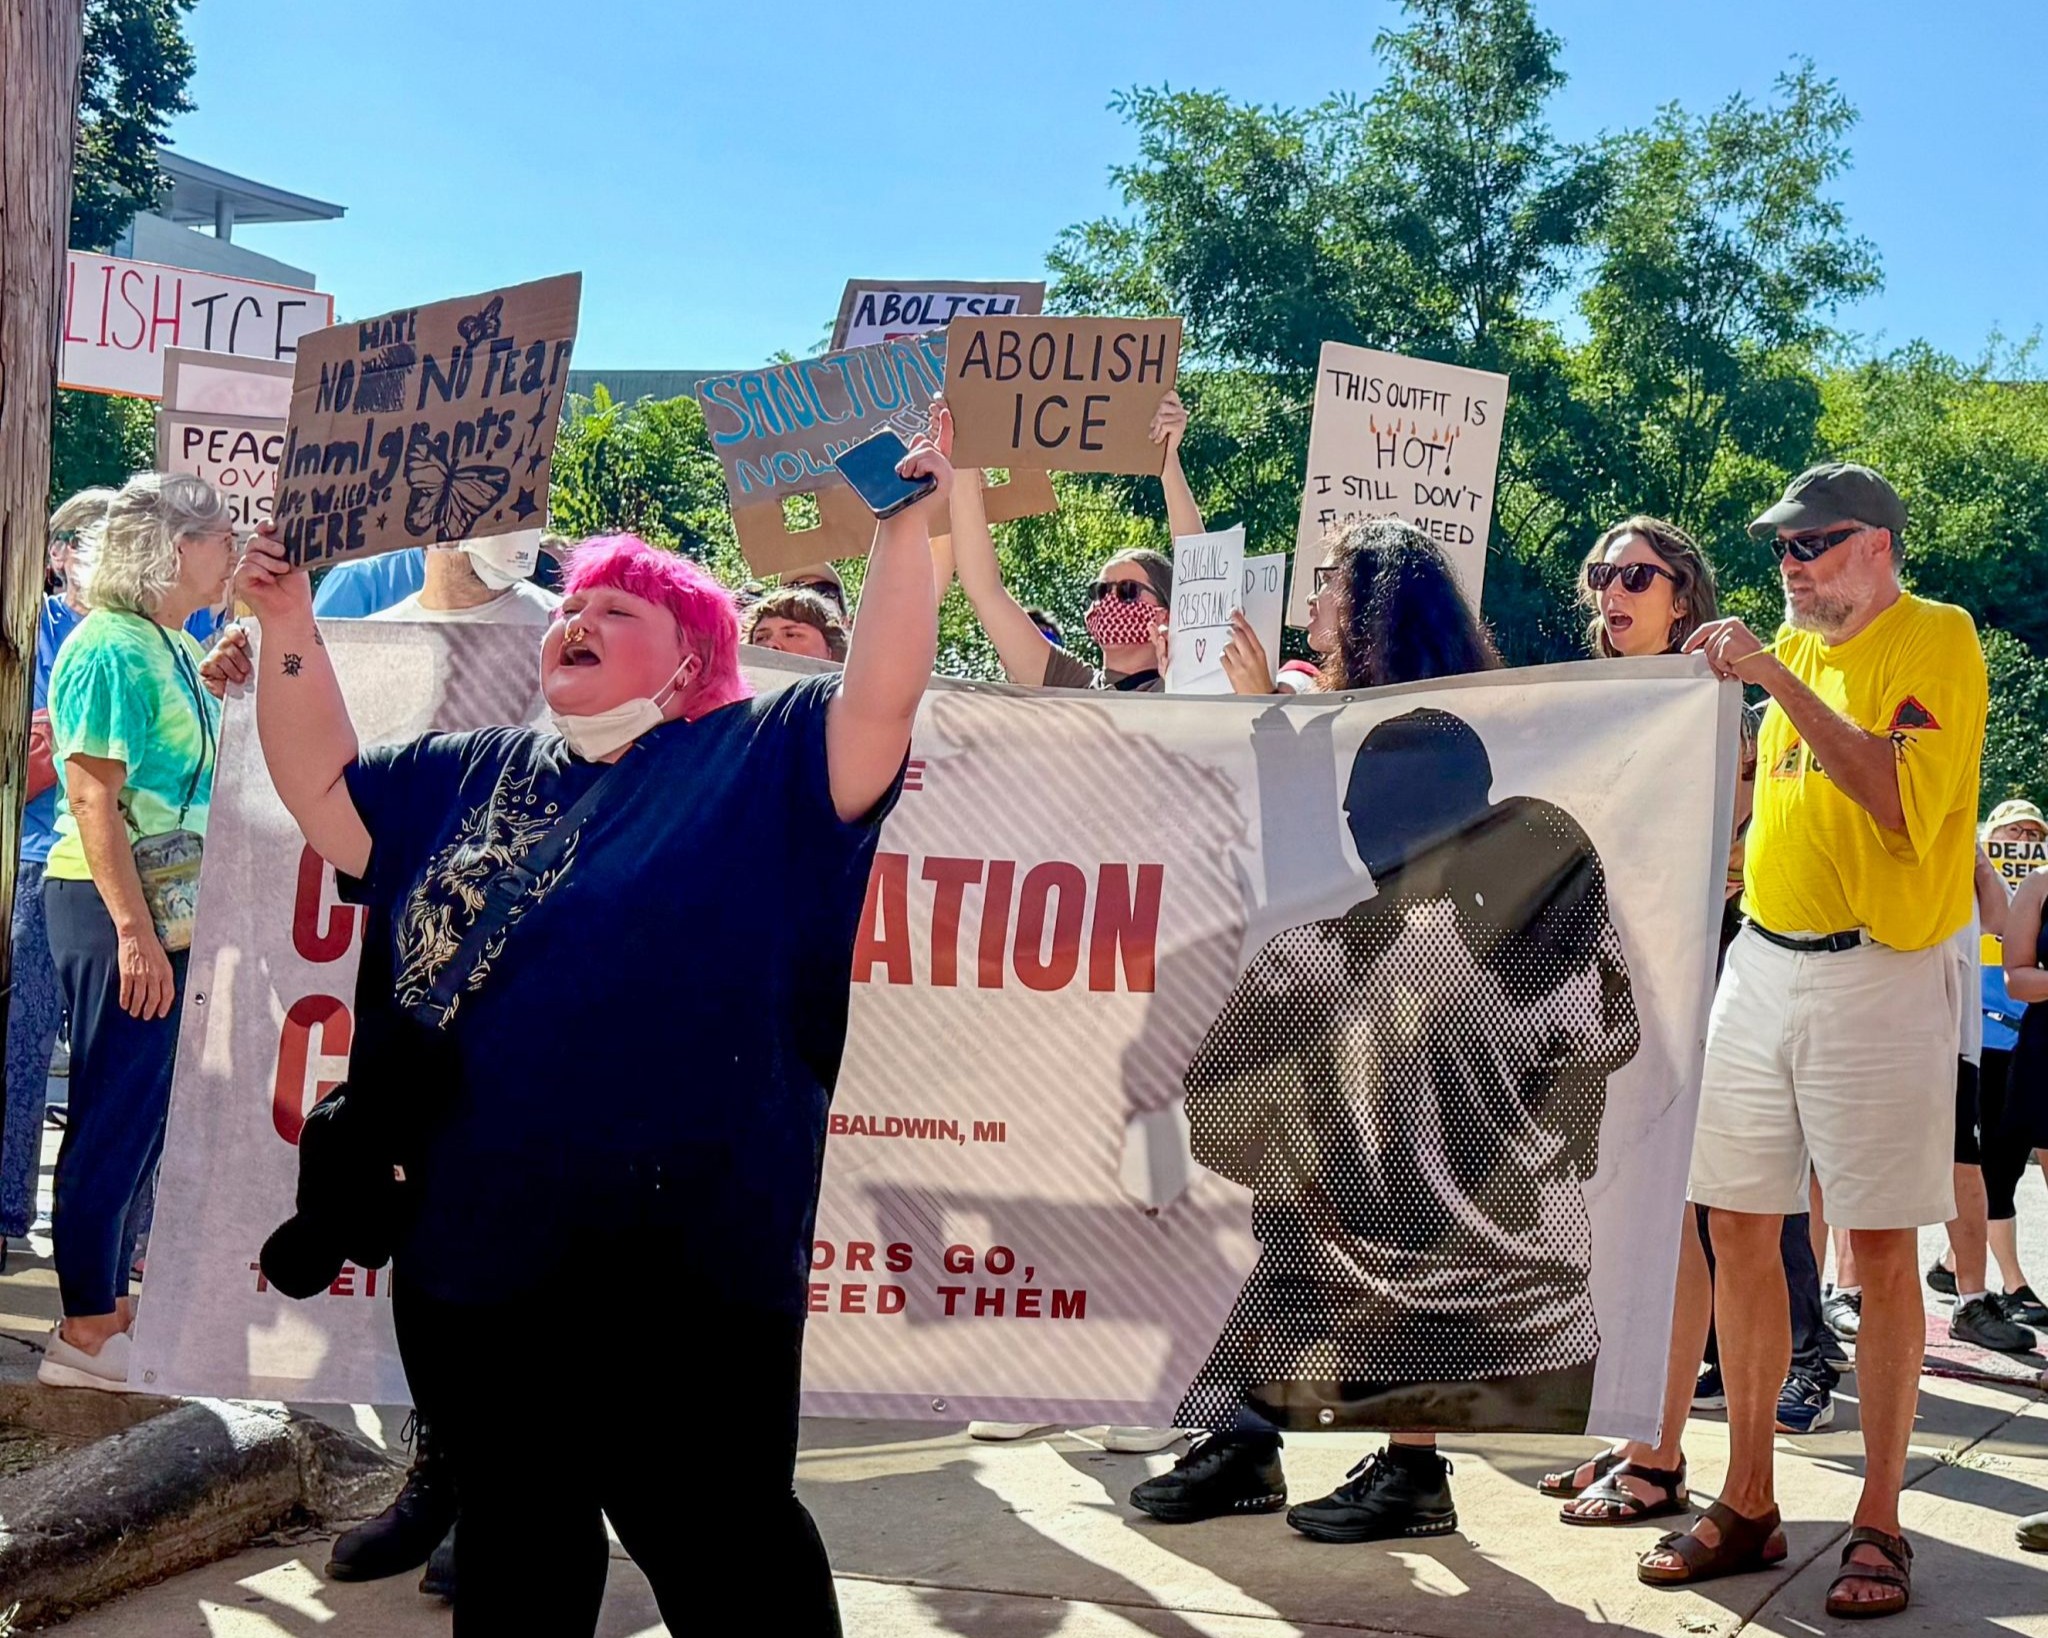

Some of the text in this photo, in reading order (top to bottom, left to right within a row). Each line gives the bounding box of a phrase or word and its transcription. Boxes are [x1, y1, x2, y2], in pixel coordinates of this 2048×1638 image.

[64, 262, 182, 353] LISH
[359, 311, 418, 351] HATE
[958, 330, 1166, 384] ABOLISH
[315, 359, 355, 413] NO
[416, 346, 473, 410] NO
[1326, 369, 1487, 426] THIS OUTFIT IS
[1012, 393, 1110, 450] ICE
[183, 427, 284, 464] PEAC
[1377, 432, 1454, 476] HOT!
[1313, 475, 1482, 512] I STILL DON'T
[284, 506, 367, 567] HERE
[1414, 517, 1474, 544] NEED
[1179, 545, 1228, 582] SINGING
[1262, 565, 1278, 592] TO
[1988, 842, 2046, 861] DEJA
[829, 1113, 1006, 1146] BALDWIN, MI
[810, 1240, 1035, 1283] ORS GO,
[808, 1283, 1087, 1319] EED THEM
